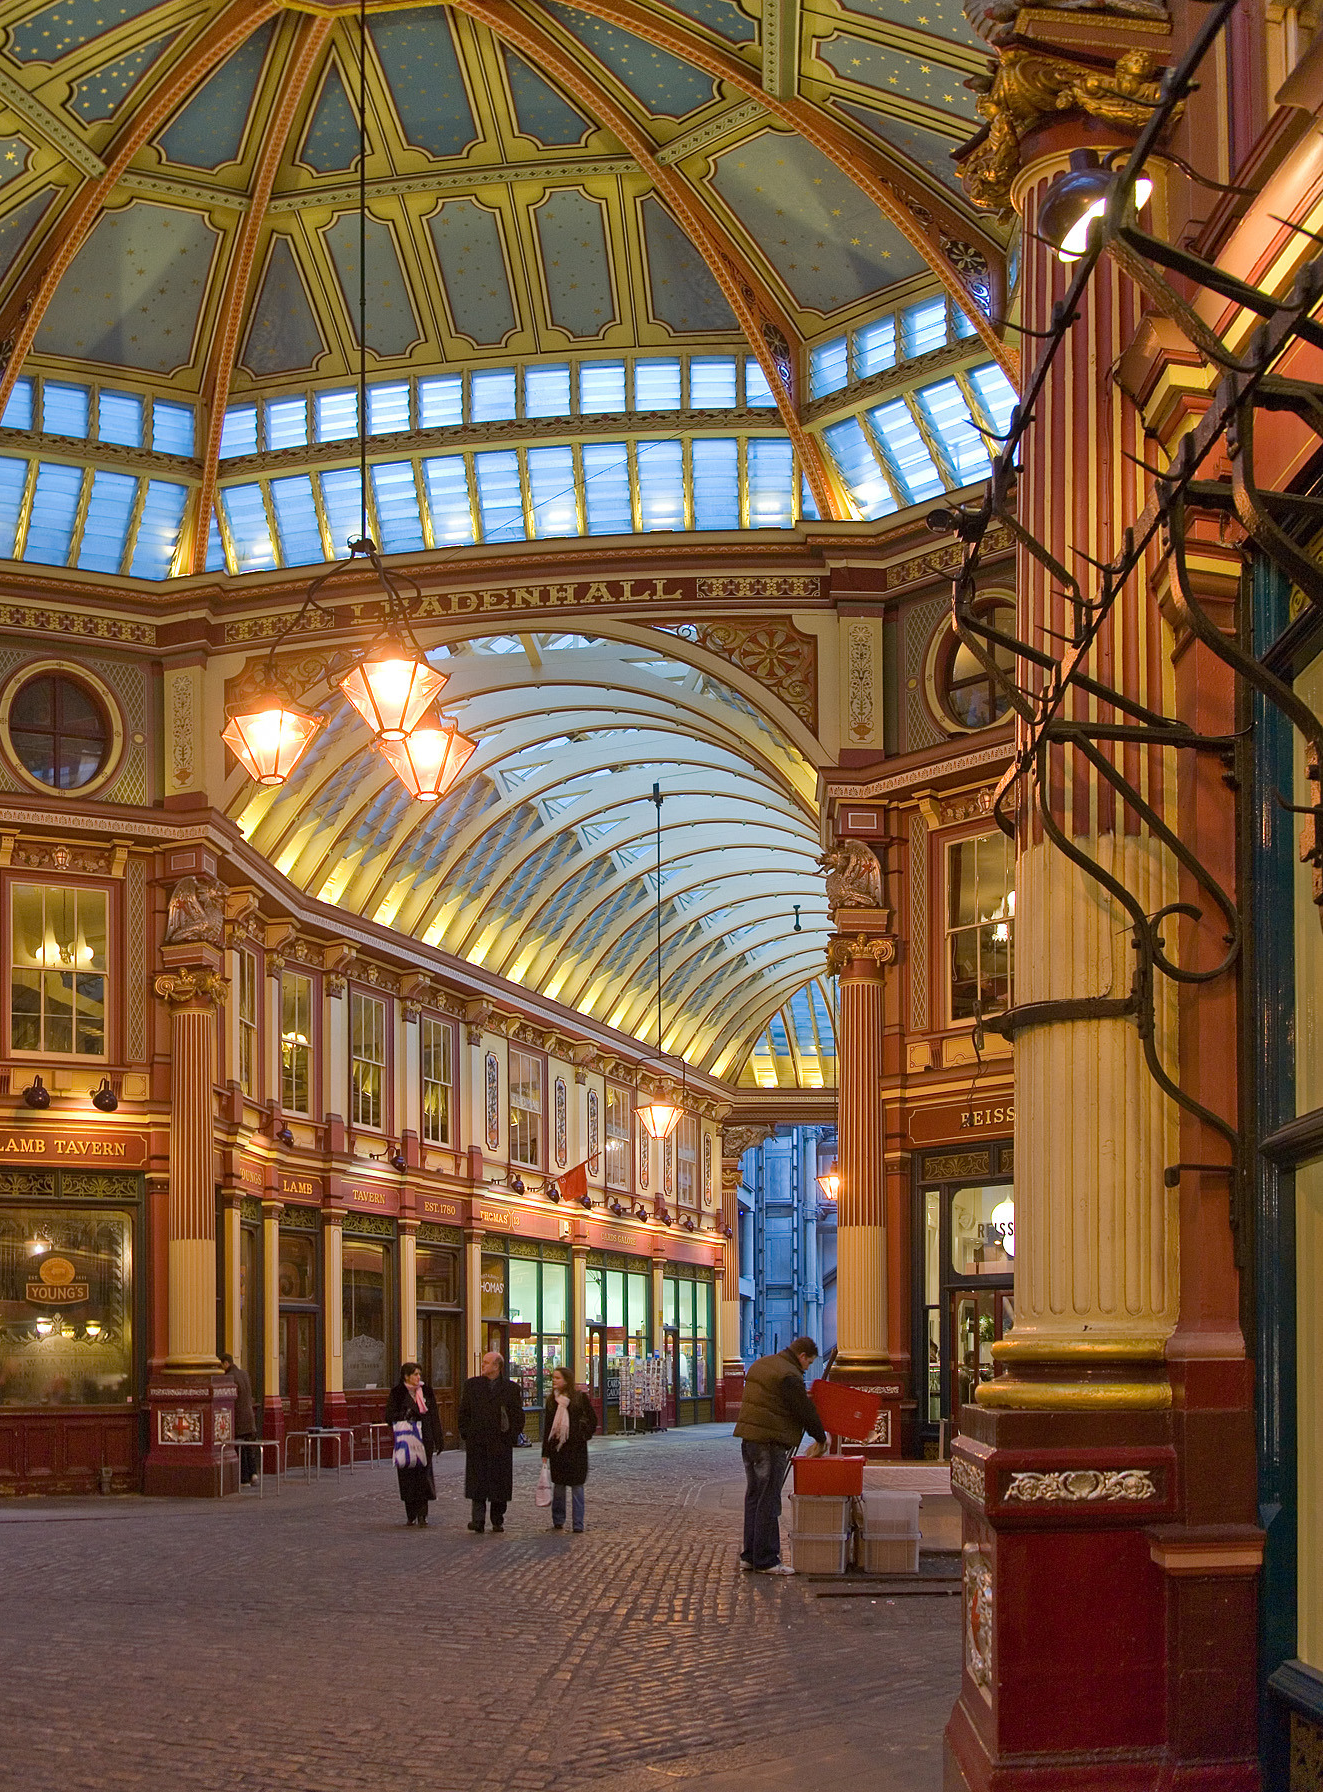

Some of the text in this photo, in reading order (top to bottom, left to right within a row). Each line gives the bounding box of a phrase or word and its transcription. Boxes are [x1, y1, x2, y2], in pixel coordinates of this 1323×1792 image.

[351, 579, 683, 625] LEADENHALL
[961, 1106, 1015, 1128] REISS
[54, 1140, 126, 1156] TAVERN
[283, 1179, 313, 1194] LAMB
[352, 1189, 386, 1204] TAVERN
[600, 1231, 617, 1242] CARDS
[618, 1235, 637, 1247] GALORE
[31, 1285, 84, 1300] YOUNG'S
